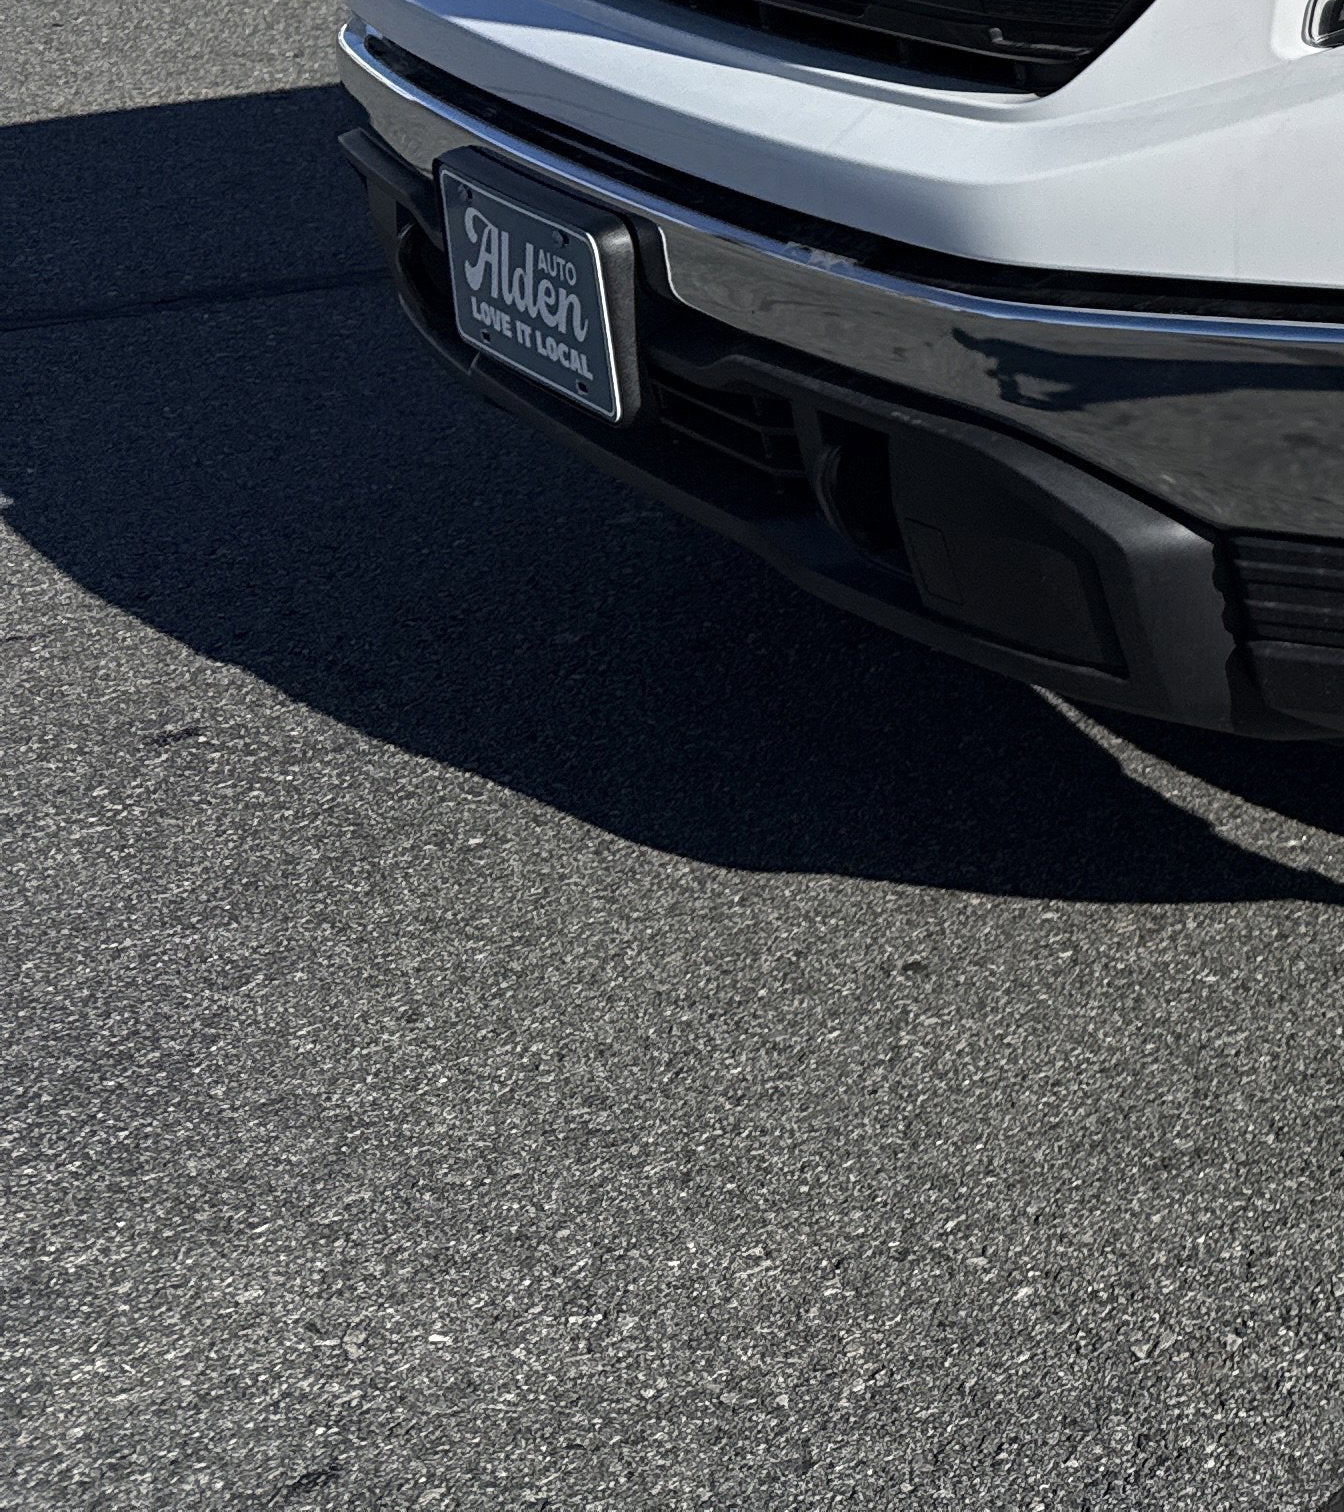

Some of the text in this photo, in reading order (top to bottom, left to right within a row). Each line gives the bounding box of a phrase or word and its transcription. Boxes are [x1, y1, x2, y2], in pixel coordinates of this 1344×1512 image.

[464, 206, 589, 343] Alden
[537, 248, 577, 287] AUTO
[470, 295, 594, 381] LOVE IT LOCAL
